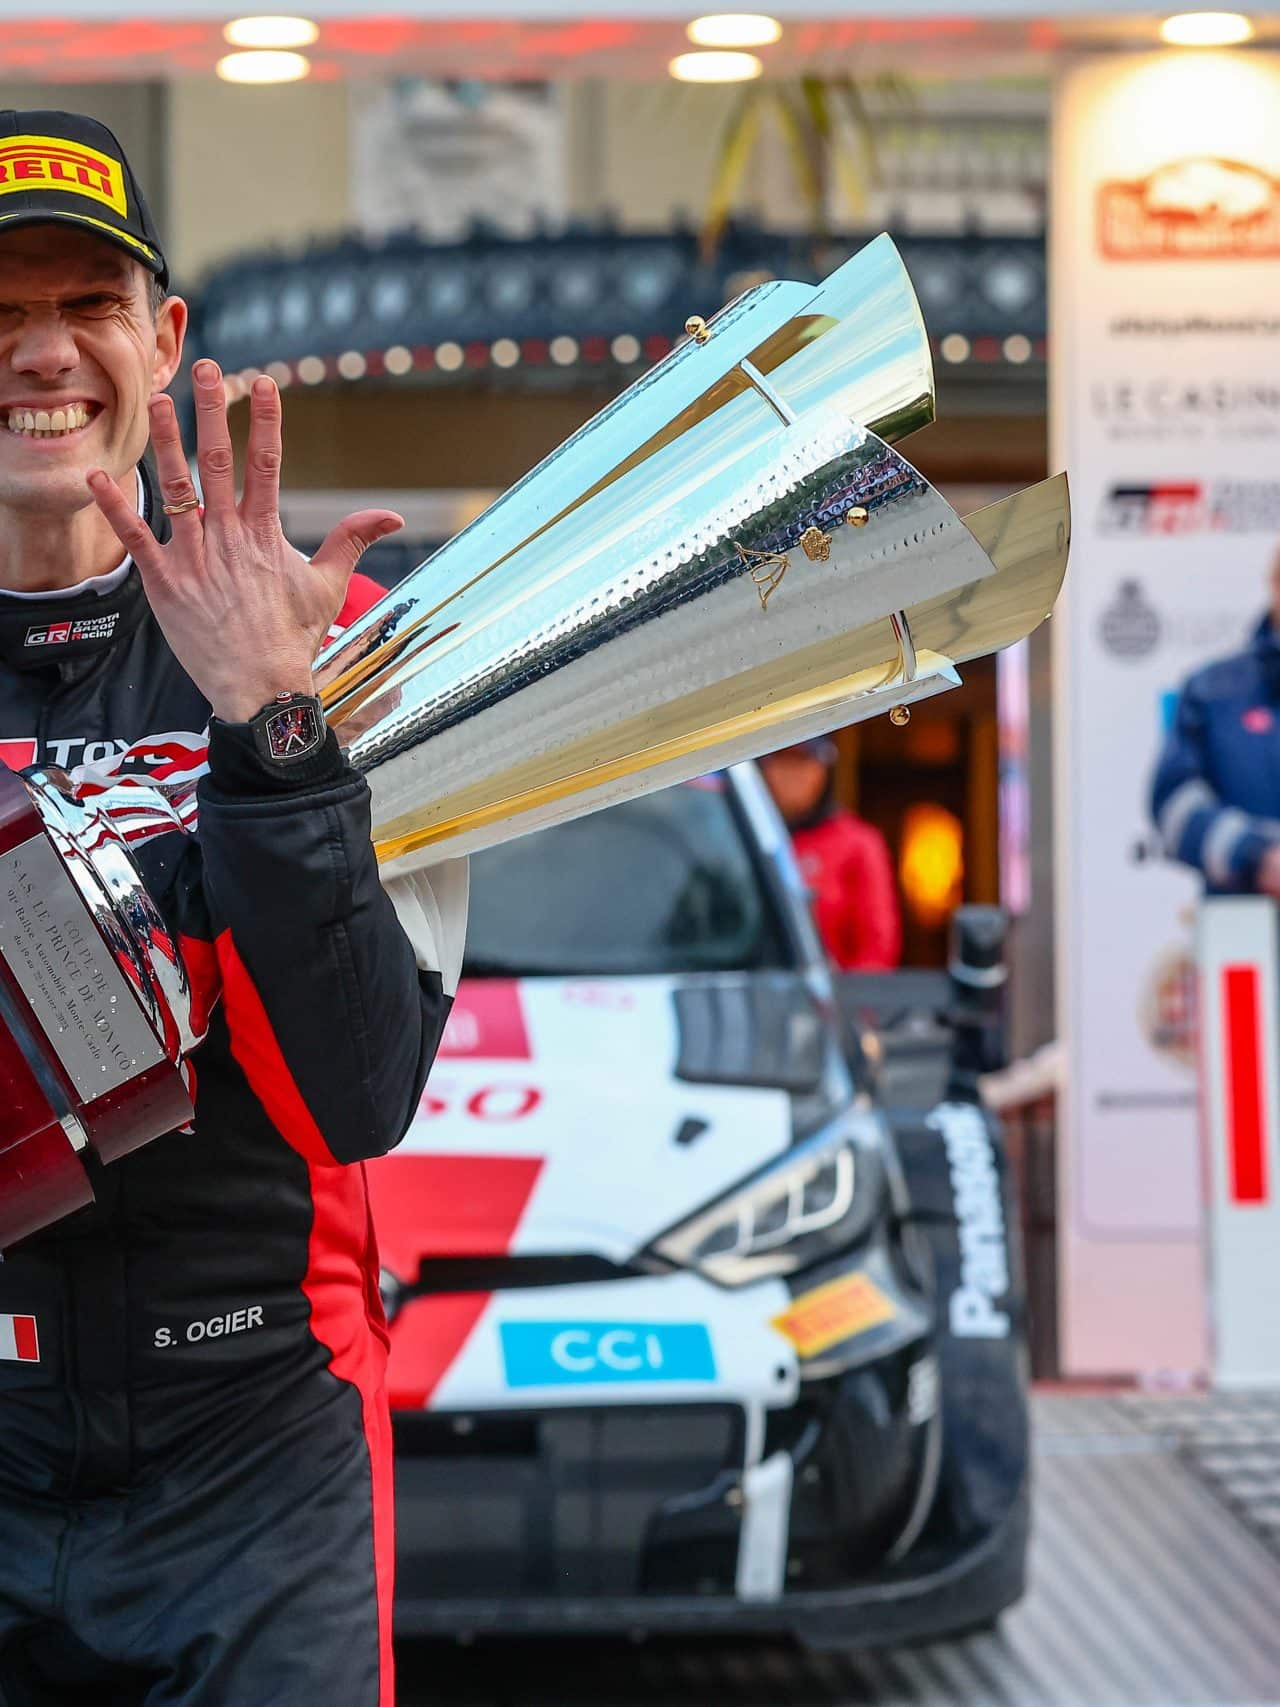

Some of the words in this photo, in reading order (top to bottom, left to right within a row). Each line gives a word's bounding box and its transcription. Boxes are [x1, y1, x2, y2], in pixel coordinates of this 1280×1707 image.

[72, 621, 115, 634] GAZOO
[73, 612, 120, 627] TOYOTA
[27, 629, 67, 645] GR
[71, 628, 114, 641] Racing
[15, 907, 36, 940] Rallye
[34, 941, 68, 997] Automobile
[31, 900, 51, 922] LE
[45, 925, 82, 981] PRINCE
[77, 983, 96, 1005] DE
[91, 1009, 132, 1072] MONACO
[90, 971, 110, 994] DE
[153, 1326, 177, 1349] S.
[186, 1305, 264, 1343] OGIER
[549, 1329, 663, 1371] CCI
